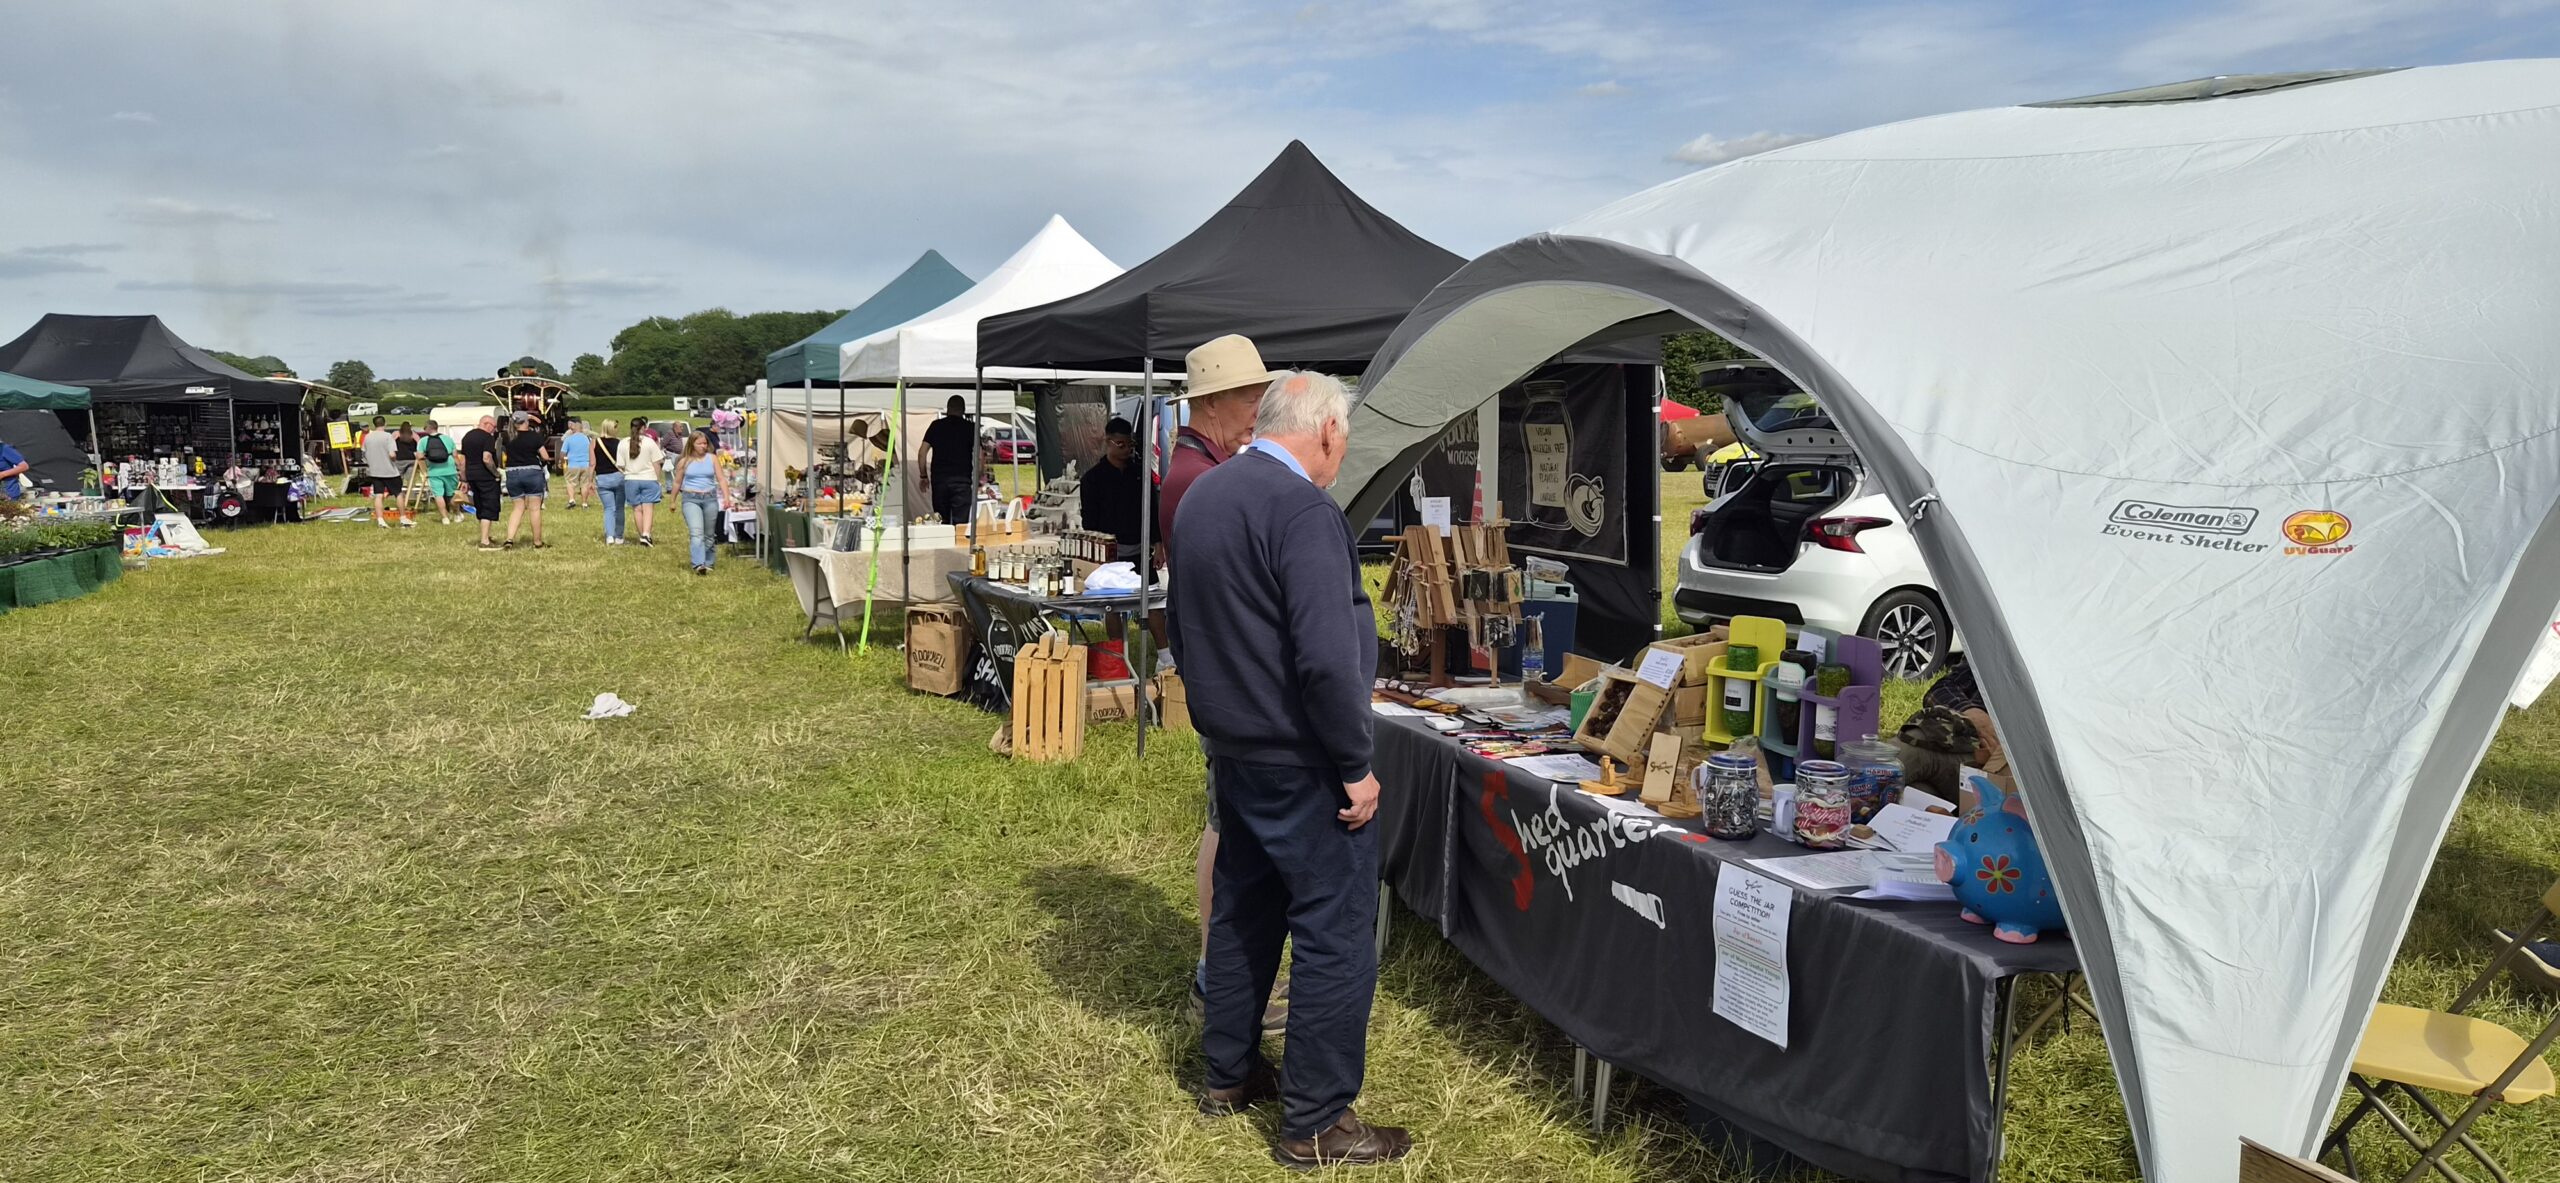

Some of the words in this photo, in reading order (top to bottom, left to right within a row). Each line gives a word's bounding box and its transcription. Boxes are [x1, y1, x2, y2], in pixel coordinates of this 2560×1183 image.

[2123, 503, 2225, 527] Coleman
[2100, 523, 2175, 544] Event
[2180, 534, 2269, 553] Shelter
[1728, 887, 1748, 901] GUESS
[1750, 895, 1762, 907] THE
[1763, 902, 1775, 912] JAR
[1729, 897, 1771, 920] COMPETITION
